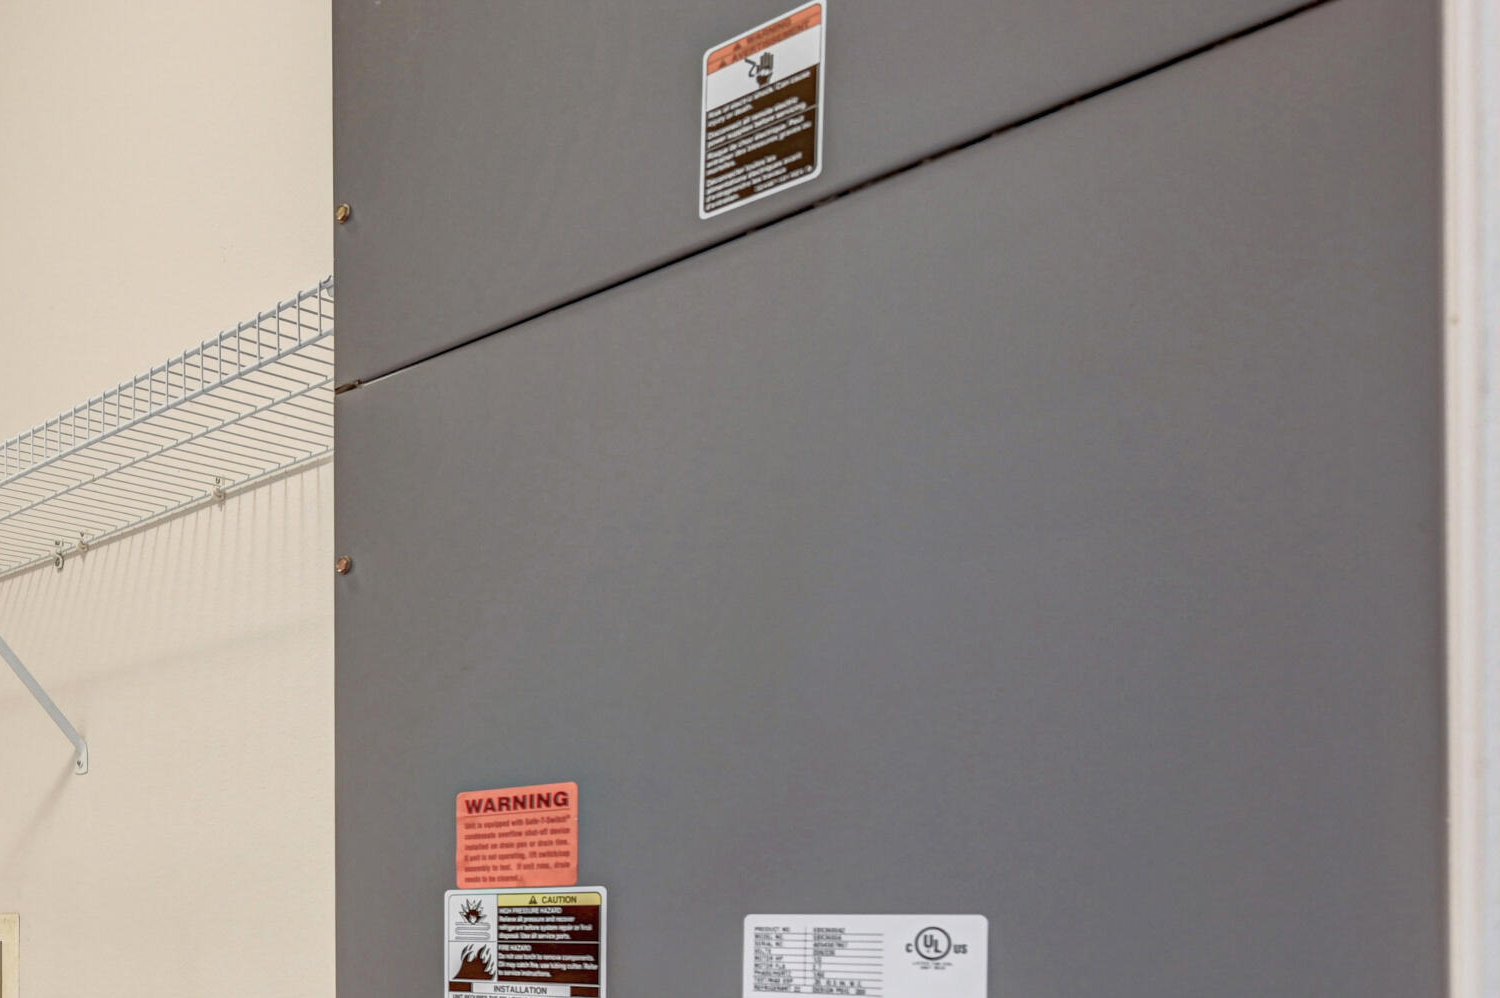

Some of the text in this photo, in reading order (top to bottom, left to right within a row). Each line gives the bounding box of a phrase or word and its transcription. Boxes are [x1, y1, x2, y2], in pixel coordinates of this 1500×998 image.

[465, 791, 568, 814] WARNING
[542, 896, 577, 904] CAUTION
[924, 934, 942, 953] UL
[953, 944, 968, 954] US
[494, 985, 547, 994] INSTALLATION
